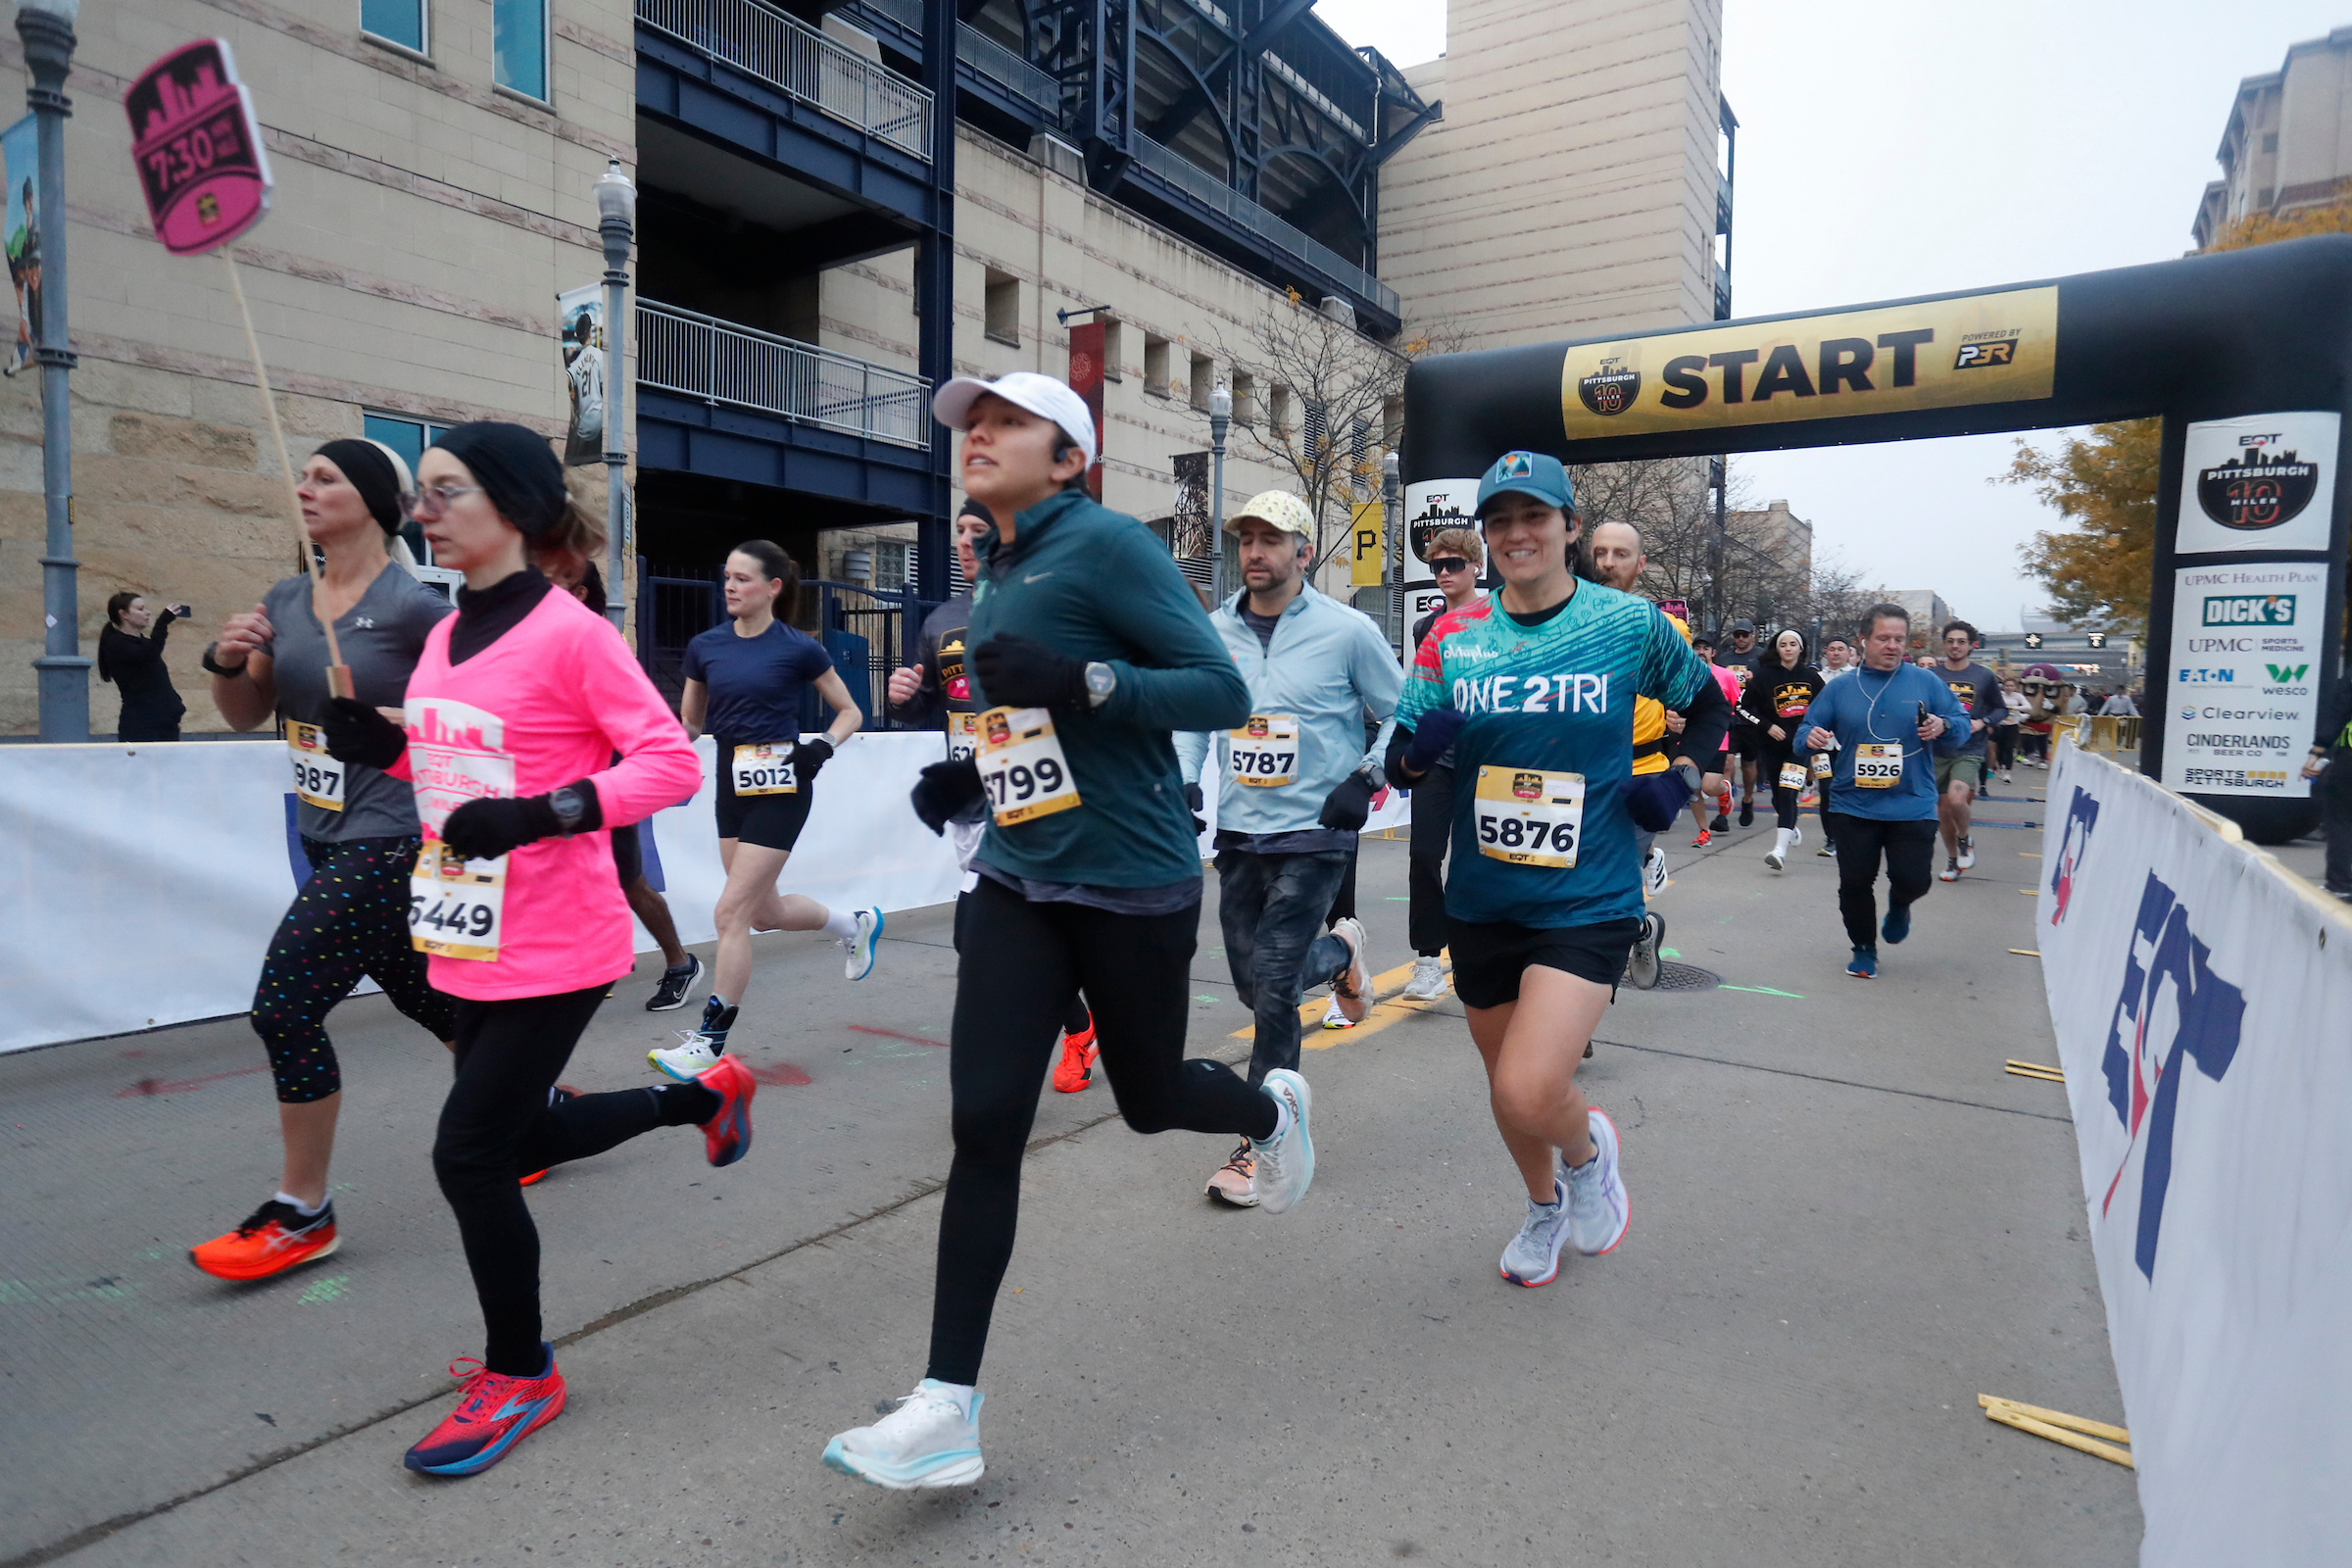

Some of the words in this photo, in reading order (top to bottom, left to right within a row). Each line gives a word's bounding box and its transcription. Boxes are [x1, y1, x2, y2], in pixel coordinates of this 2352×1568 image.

[149, 129, 215, 191] 7:30
[1962, 329, 2006, 342] POWERED
[1660, 328, 1934, 409] START
[1584, 373, 1636, 385] PITTSBURGH
[1594, 383, 1622, 412] 10
[2238, 433, 2282, 447] EQT
[2207, 466, 2310, 481] PITTSBURGH
[1427, 494, 1449, 503] EQT
[2227, 478, 2282, 524] 10
[2230, 497, 2278, 506] MILER
[1413, 517, 1468, 528] PITTSBURGH
[1356, 529, 1376, 561] P
[2184, 573, 2229, 586] UPMC
[1416, 595, 1446, 612] EQ
[2206, 598, 2292, 623] DICK'S
[2188, 638, 2253, 653] UPMC
[942, 663, 964, 678] PITT
[2202, 707, 2299, 720] Clearview
[2186, 733, 2290, 749] CINDERLANDS
[1233, 750, 1295, 774] 5787
[739, 767, 792, 788] 5012
[1857, 764, 1900, 776] 5926
[2185, 768, 2245, 778] SPORTS
[294, 762, 340, 796] 987
[2184, 776, 2284, 788] PITTSBURGH
[1480, 814, 1575, 853] 5876
